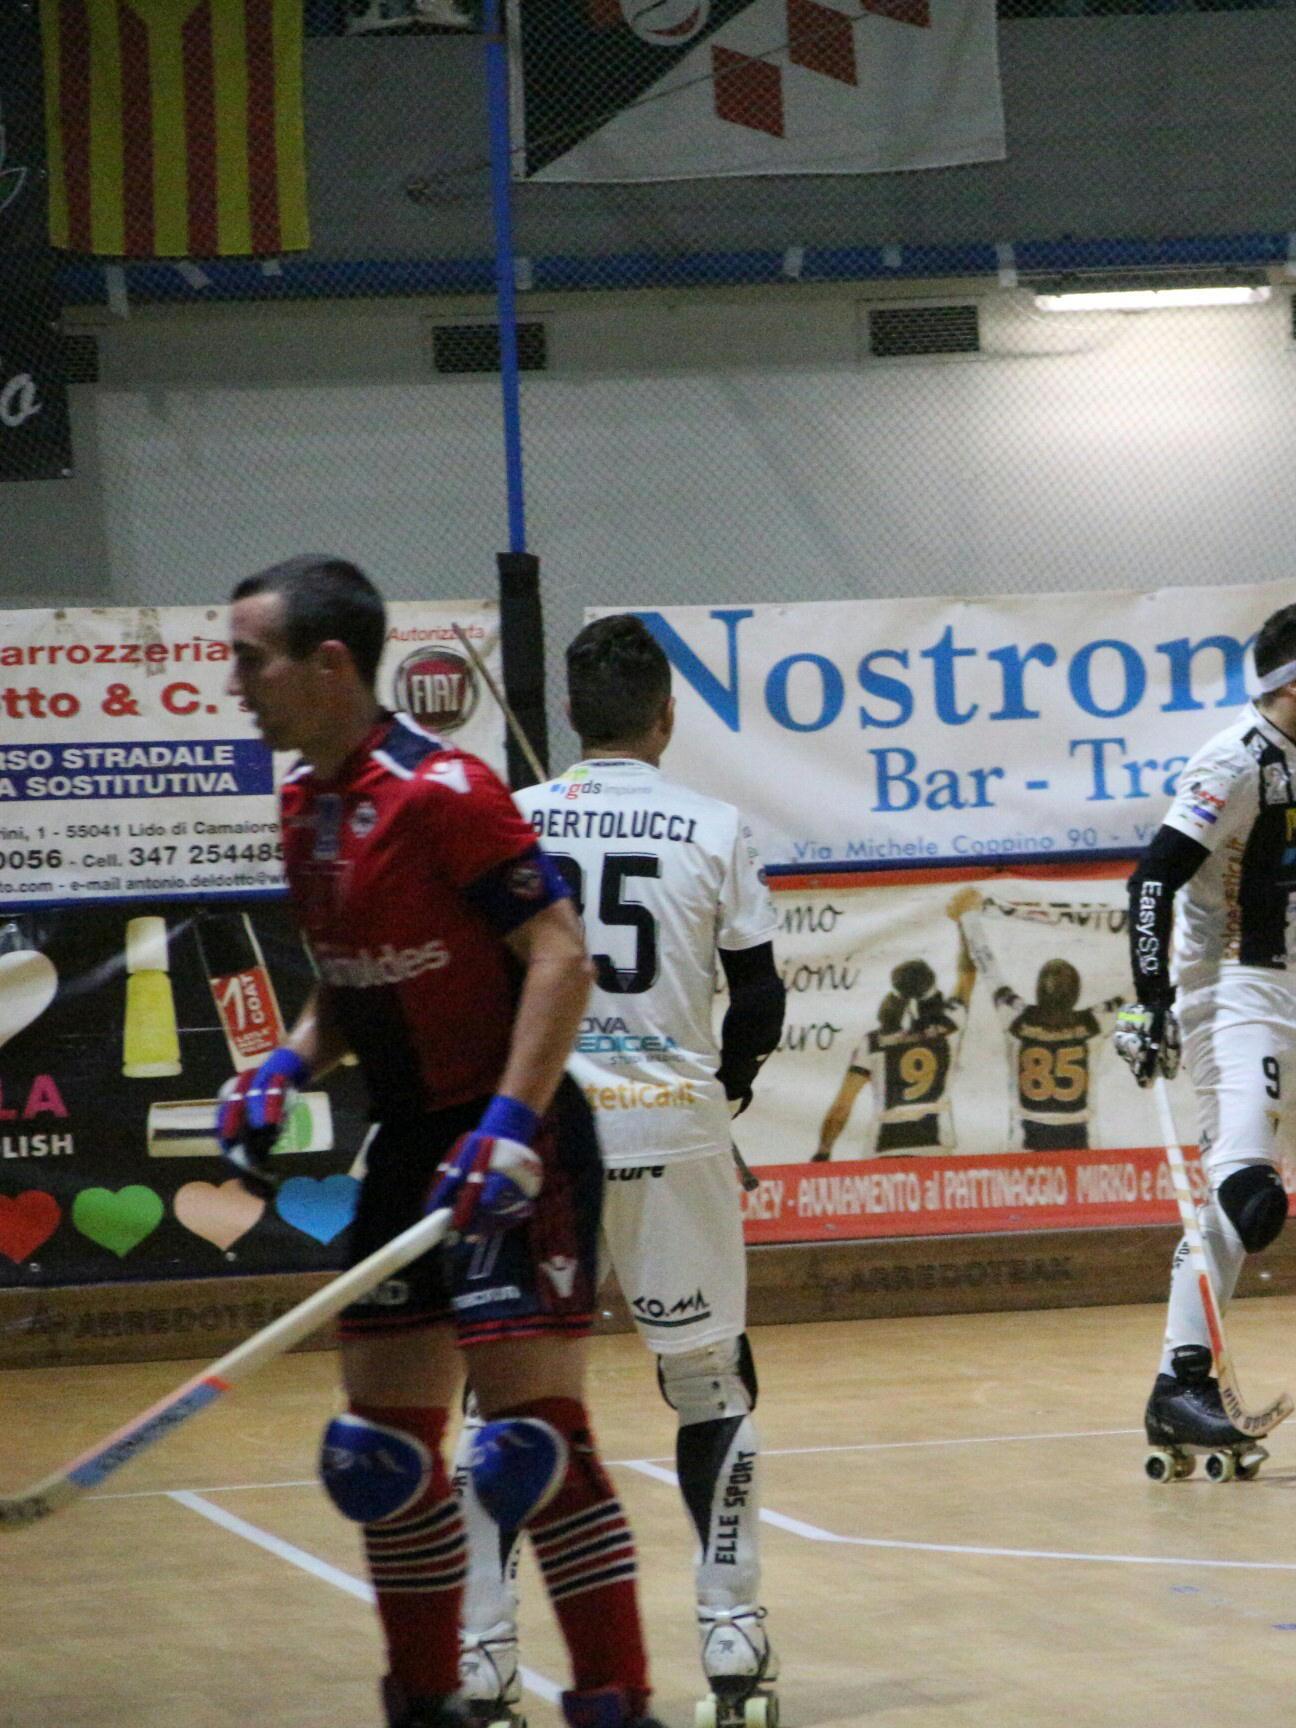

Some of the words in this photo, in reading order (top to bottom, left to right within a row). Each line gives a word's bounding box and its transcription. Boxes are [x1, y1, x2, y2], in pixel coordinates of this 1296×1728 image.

[0, 641, 231, 666] arrozzeria
[101, 683, 142, 717] &
[160, 682, 219, 715] C.
[411, 673, 463, 713] FIAT
[62, 745, 235, 769] STRADALE
[26, 772, 239, 797] SOSTITUTIVA
[868, 746, 1005, 813] Bar
[1070, 737, 1191, 801] Tra
[66, 824, 121, 839] 55041
[129, 823, 166, 837] Lido
[171, 822, 188, 836] di
[193, 821, 279, 836] Camaiore
[531, 808, 697, 843] BERTOLUCCI
[82, 854, 123, 868] Cell.
[129, 846, 177, 867] 347
[794, 841, 832, 861] Via
[847, 837, 939, 859] Michele
[953, 832, 1054, 857] Coppino
[1067, 828, 1098, 847] 90
[70, 877, 122, 892] e-mail
[900, 1047, 937, 1100] 9
[1019, 1046, 1088, 1101] 85
[1262, 1056, 1281, 1100] 9
[2, 1133, 75, 1159] LISH
[943, 1166, 1069, 1210] PATTINAGGIO
[1075, 1163, 1137, 1205] MIRKO
[723, 1450, 757, 1507] SPORT
[714, 1514, 739, 1565] ELLE
